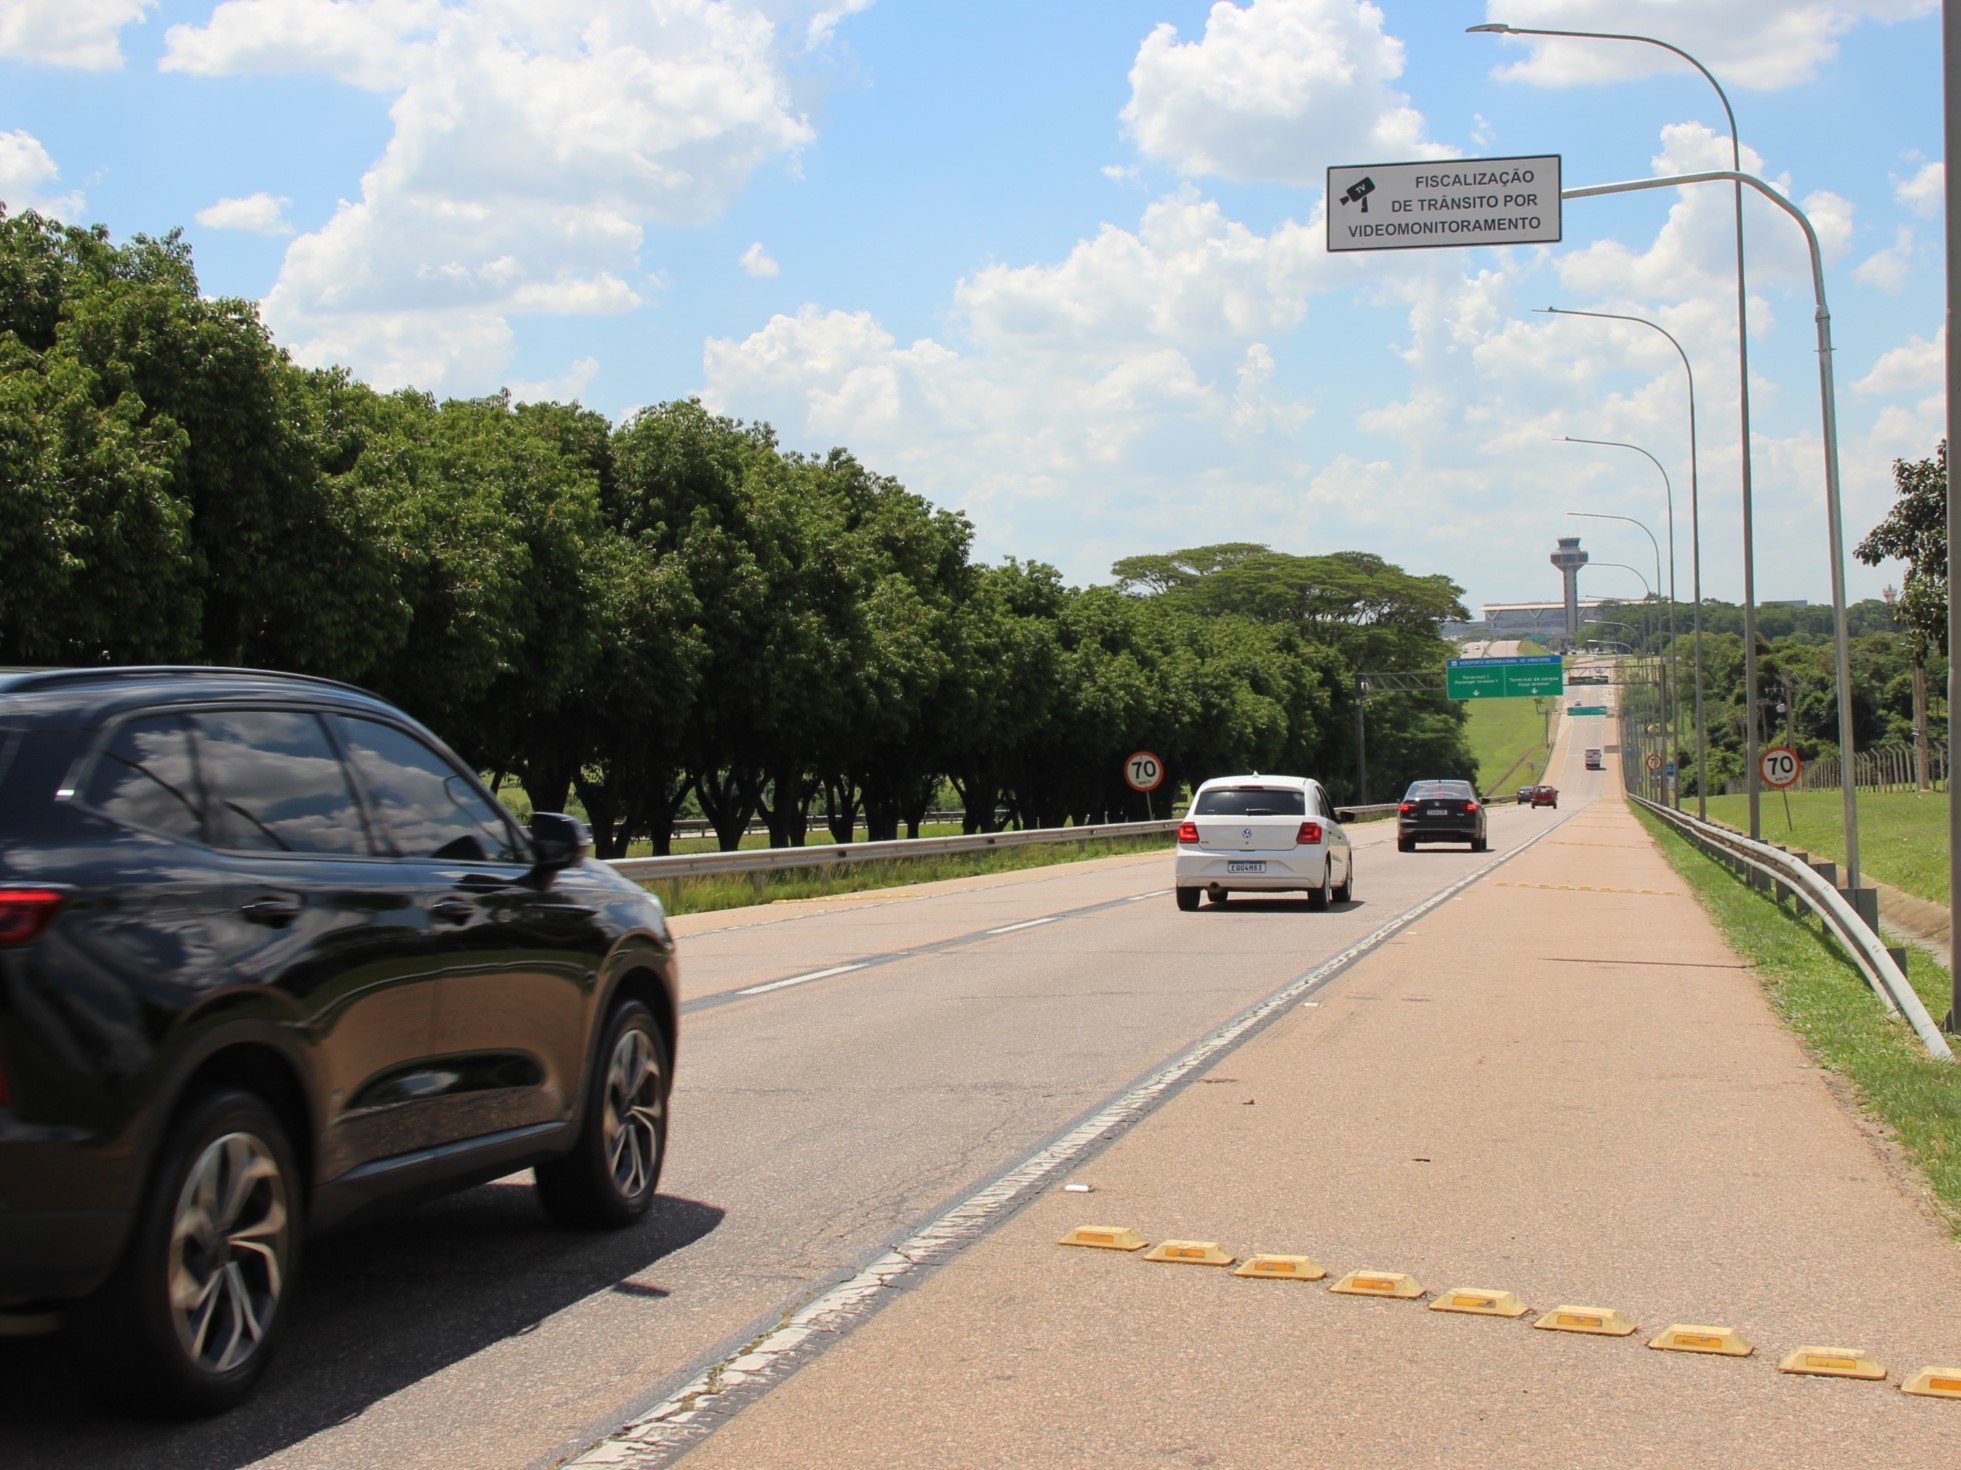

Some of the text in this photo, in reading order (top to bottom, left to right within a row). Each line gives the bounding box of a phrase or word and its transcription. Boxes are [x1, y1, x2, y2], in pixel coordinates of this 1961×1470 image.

[1415, 168, 1534, 188] FISCALIZAÇÃO
[1355, 183, 1366, 194] TV
[1392, 194, 1538, 212] DE TRÂNSITO POR
[1348, 216, 1541, 238] VIDEOMONITORAMENTO
[1131, 760, 1156, 779] 70
[1767, 756, 1793, 775] 70
